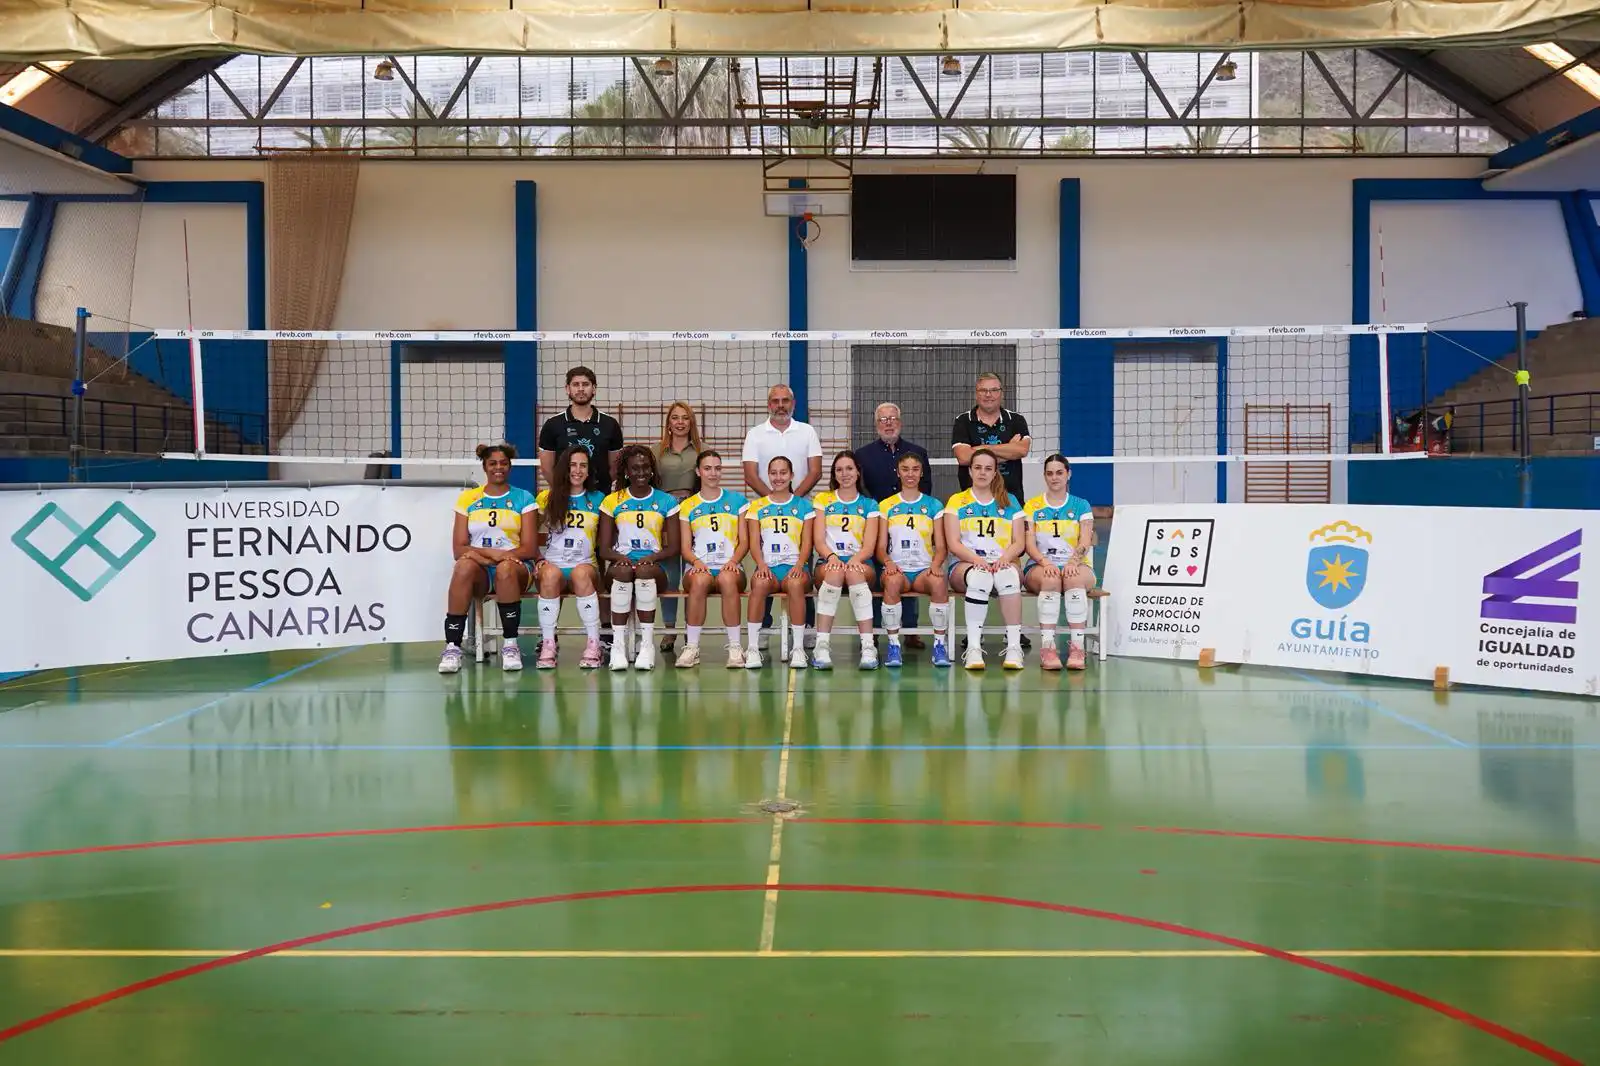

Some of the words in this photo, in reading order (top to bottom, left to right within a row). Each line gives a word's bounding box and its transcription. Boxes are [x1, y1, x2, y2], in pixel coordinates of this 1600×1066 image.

[275, 330, 312, 338] rfevb.com
[374, 331, 412, 339] rfevb.com
[473, 331, 510, 339] rfevb.com
[572, 331, 610, 339] rfevb.com
[672, 331, 709, 339] rfevb.com
[771, 331, 809, 339] rfevb.com
[870, 330, 908, 338] rfevb.com
[970, 329, 1007, 337] rfevb.com
[1069, 328, 1107, 336] rfevb.com
[1169, 327, 1206, 335] rfevb.com
[1268, 326, 1306, 334] rfevb.com
[185, 500, 340, 520] UNIVERSIDAD
[488, 510, 497, 527] 3
[566, 512, 585, 529] 22
[636, 513, 644, 528] 8
[710, 516, 719, 532] 5
[772, 518, 789, 534] 15
[841, 517, 850, 532] 2
[906, 516, 915, 530] 4
[976, 519, 996, 538] 14
[1052, 522, 1061, 538] 1
[186, 523, 412, 559] FERNANDO
[187, 566, 342, 603] PESSOA
[1134, 595, 1187, 606] SOCIEDAD
[1190, 597, 1204, 606] DE
[1132, 607, 1201, 620] PROMOCIÓN
[186, 602, 386, 644] CANARIAS
[1130, 621, 1201, 634] DESARROLLO
[1479, 623, 1554, 639] Concejalía
[1558, 629, 1577, 640] de
[1277, 642, 1380, 659] AYUNTAMIENTO
[1478, 640, 1576, 659] IGUALDAD
[1476, 658, 1490, 667] de
[1493, 660, 1575, 674] oportunidades
